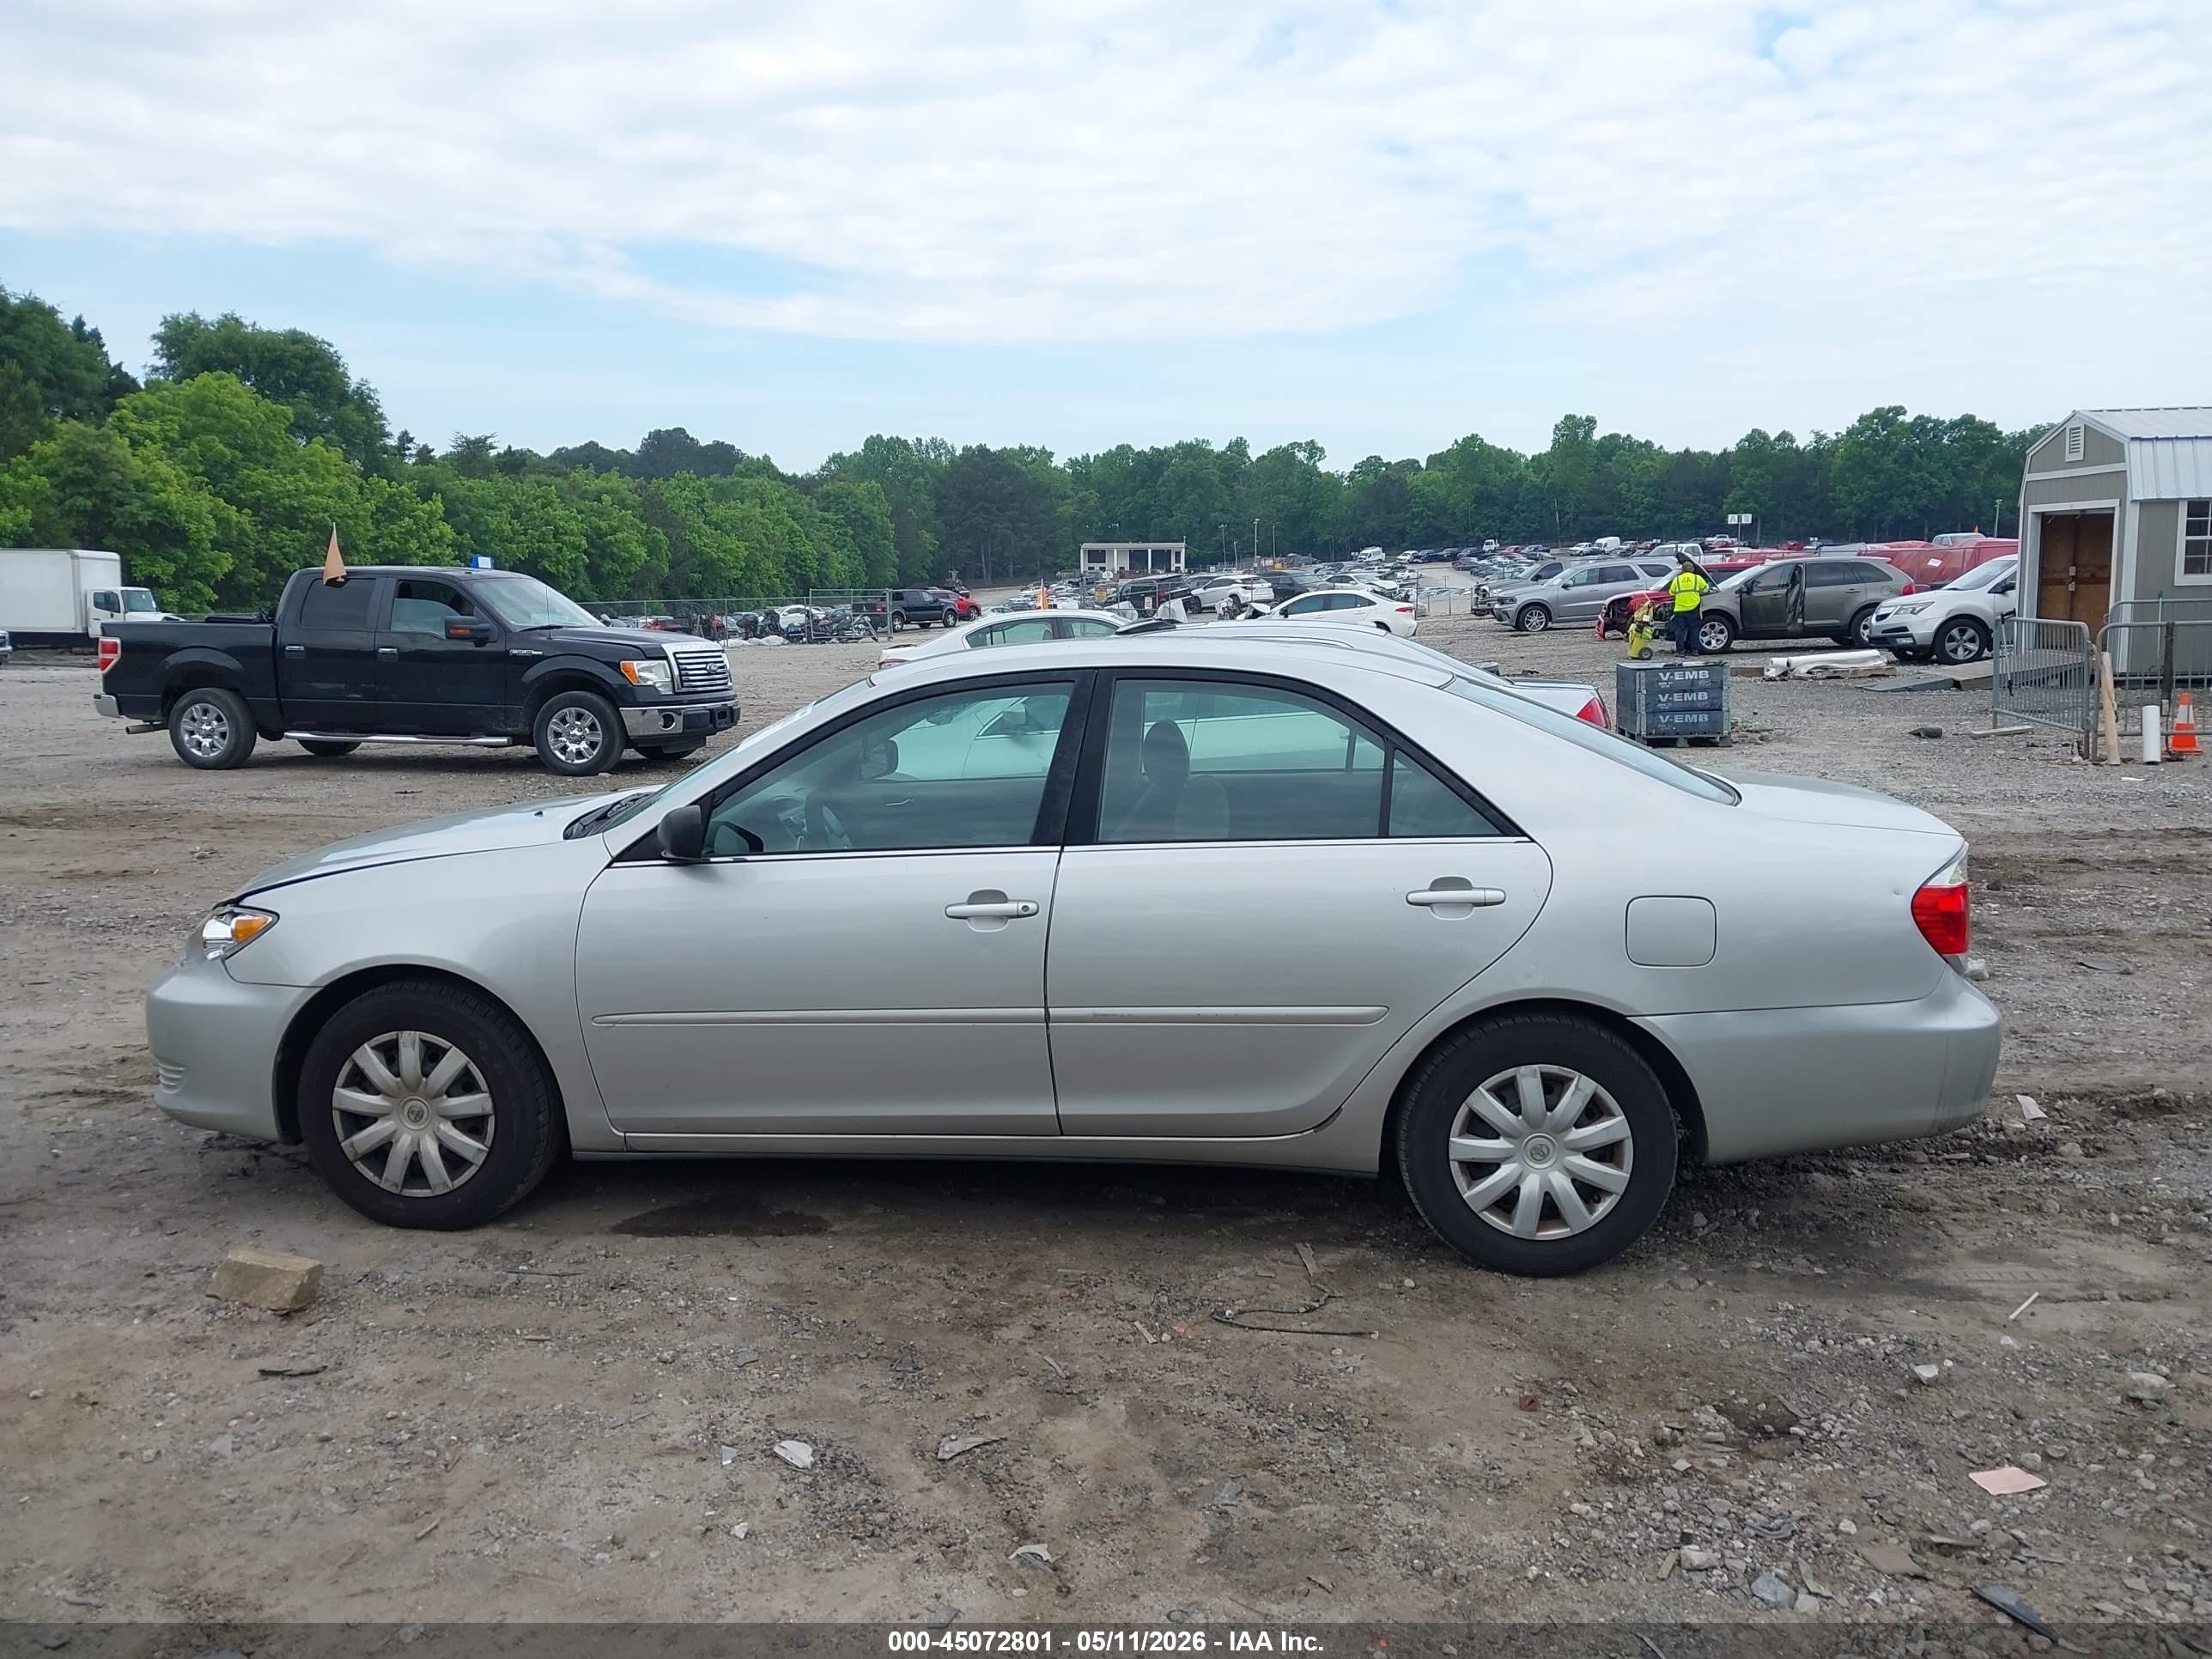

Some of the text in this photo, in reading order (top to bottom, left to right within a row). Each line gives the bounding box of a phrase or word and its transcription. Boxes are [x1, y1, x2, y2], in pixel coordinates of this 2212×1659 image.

[1659, 671, 1710, 681] V-EMB
[1658, 692, 1709, 702] V-EMB
[1659, 714, 1709, 723] V-EMB
